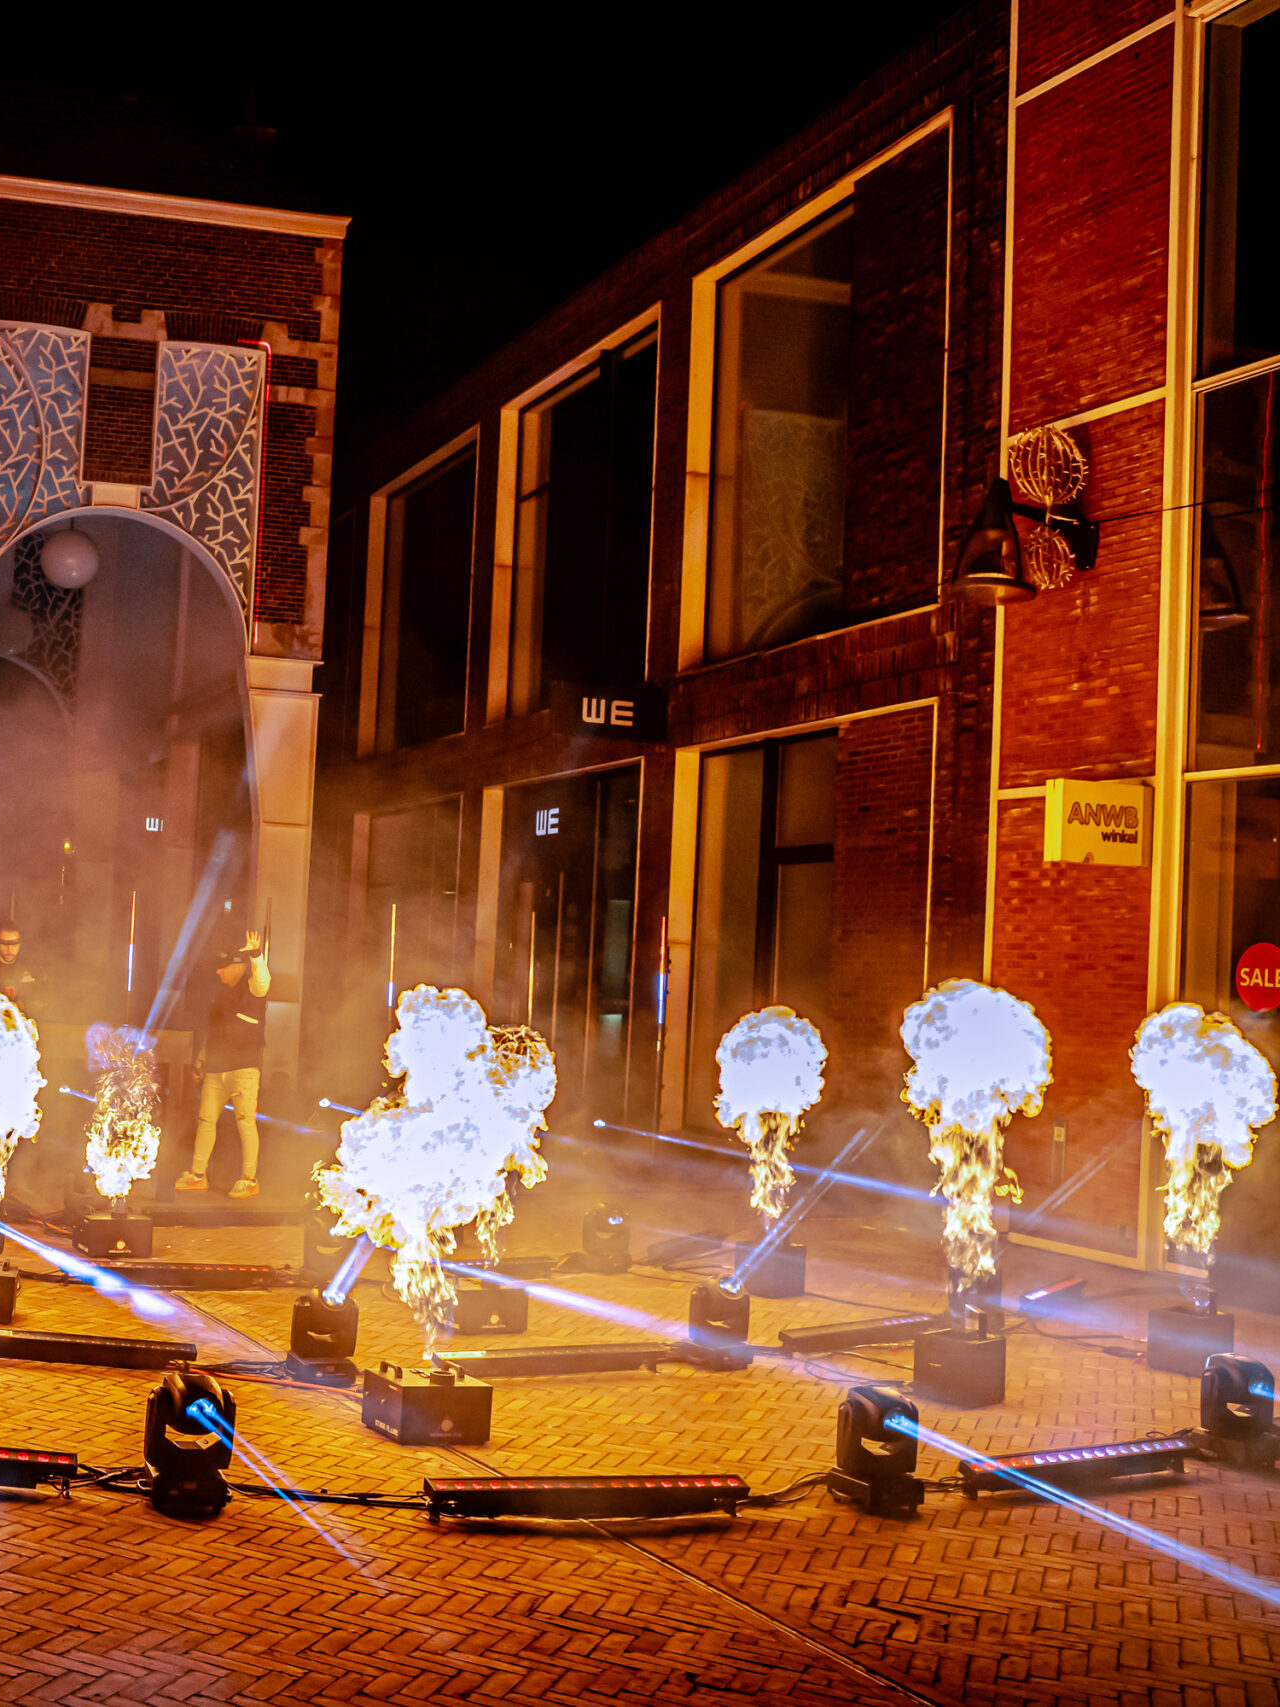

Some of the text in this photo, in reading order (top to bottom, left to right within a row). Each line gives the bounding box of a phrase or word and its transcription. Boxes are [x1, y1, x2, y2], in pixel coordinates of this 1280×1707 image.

[581, 696, 635, 727] WE
[145, 816, 164, 832] W
[535, 807, 560, 836] WE
[1067, 800, 1139, 829] ANWB
[1101, 829, 1138, 844] winkel
[1239, 967, 1280, 988] SALE
